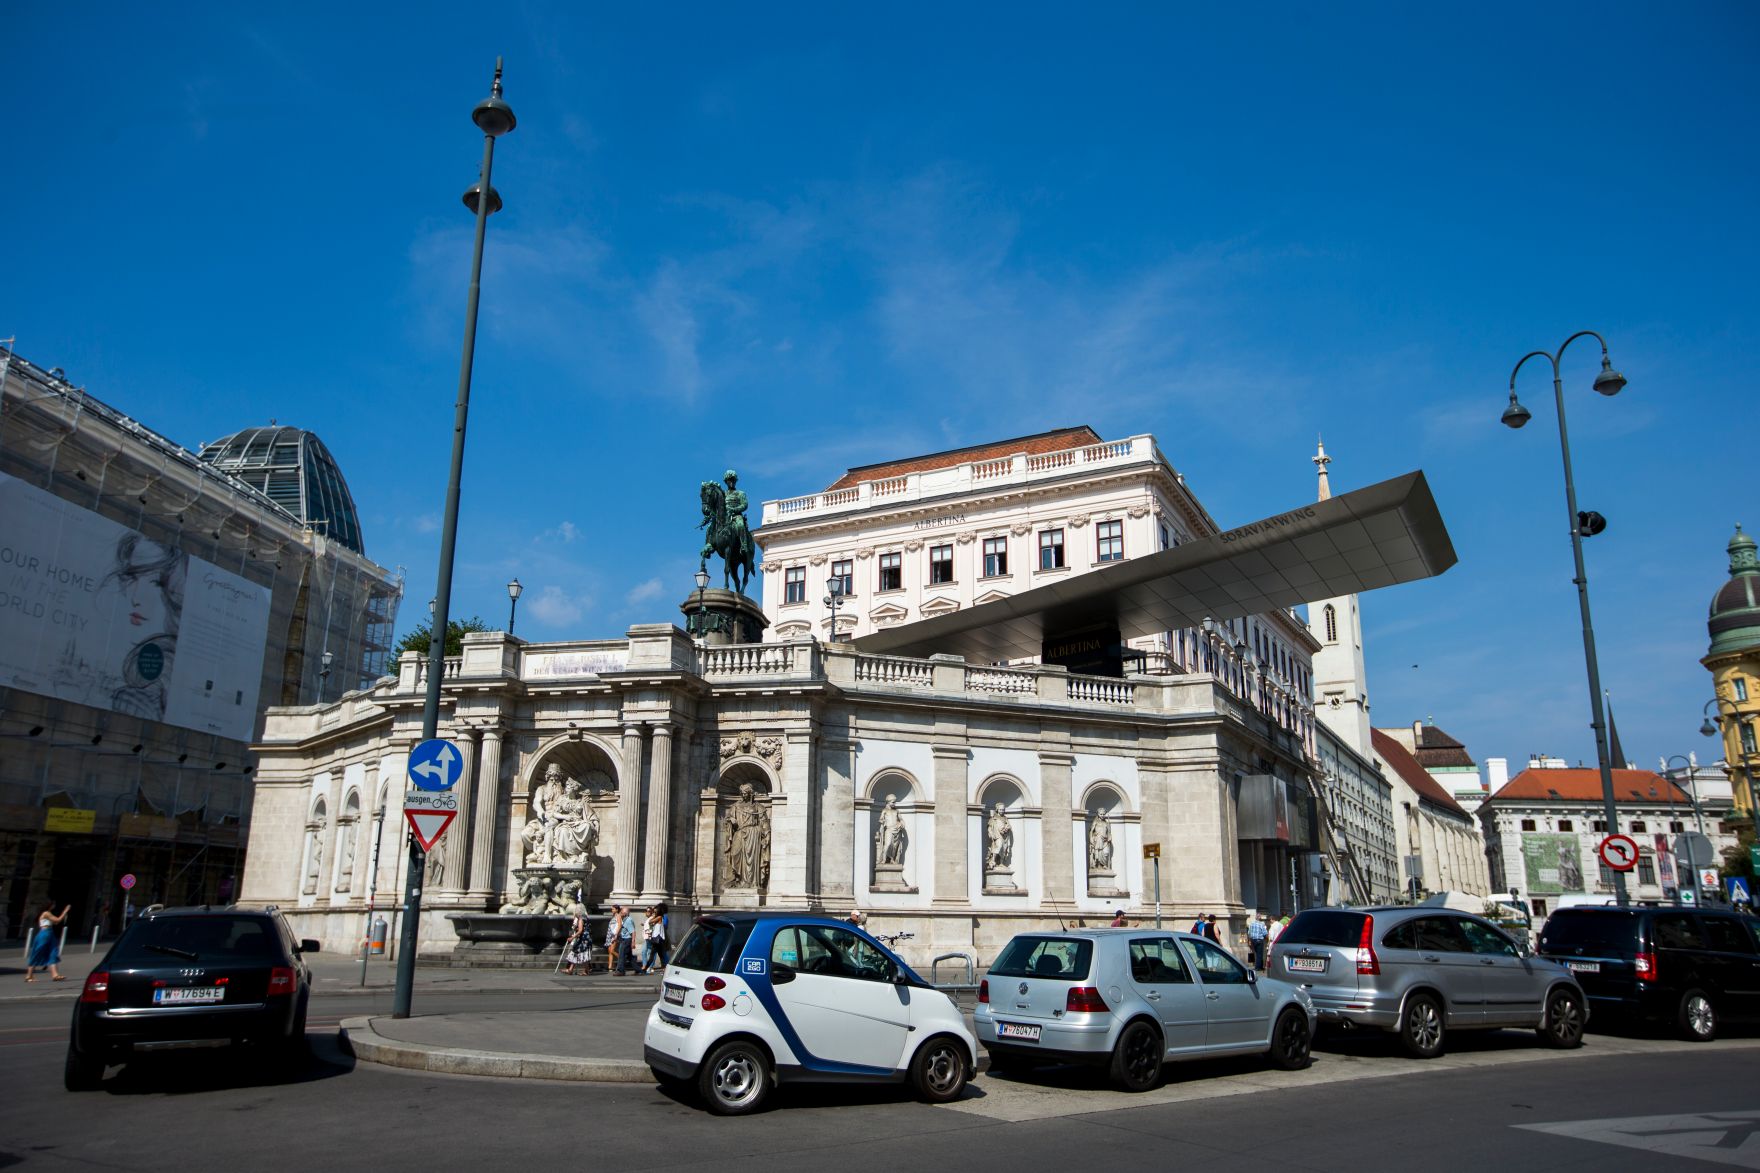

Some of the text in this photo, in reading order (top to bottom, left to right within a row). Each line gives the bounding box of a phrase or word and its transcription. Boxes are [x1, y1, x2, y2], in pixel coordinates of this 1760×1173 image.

[913, 514, 966, 530] ALBERTINA
[1220, 507, 1316, 544] SORAVIA WING
[46, 566, 95, 592] HOME
[52, 609, 89, 633] CITY
[1046, 639, 1101, 659] ALBERTINA
